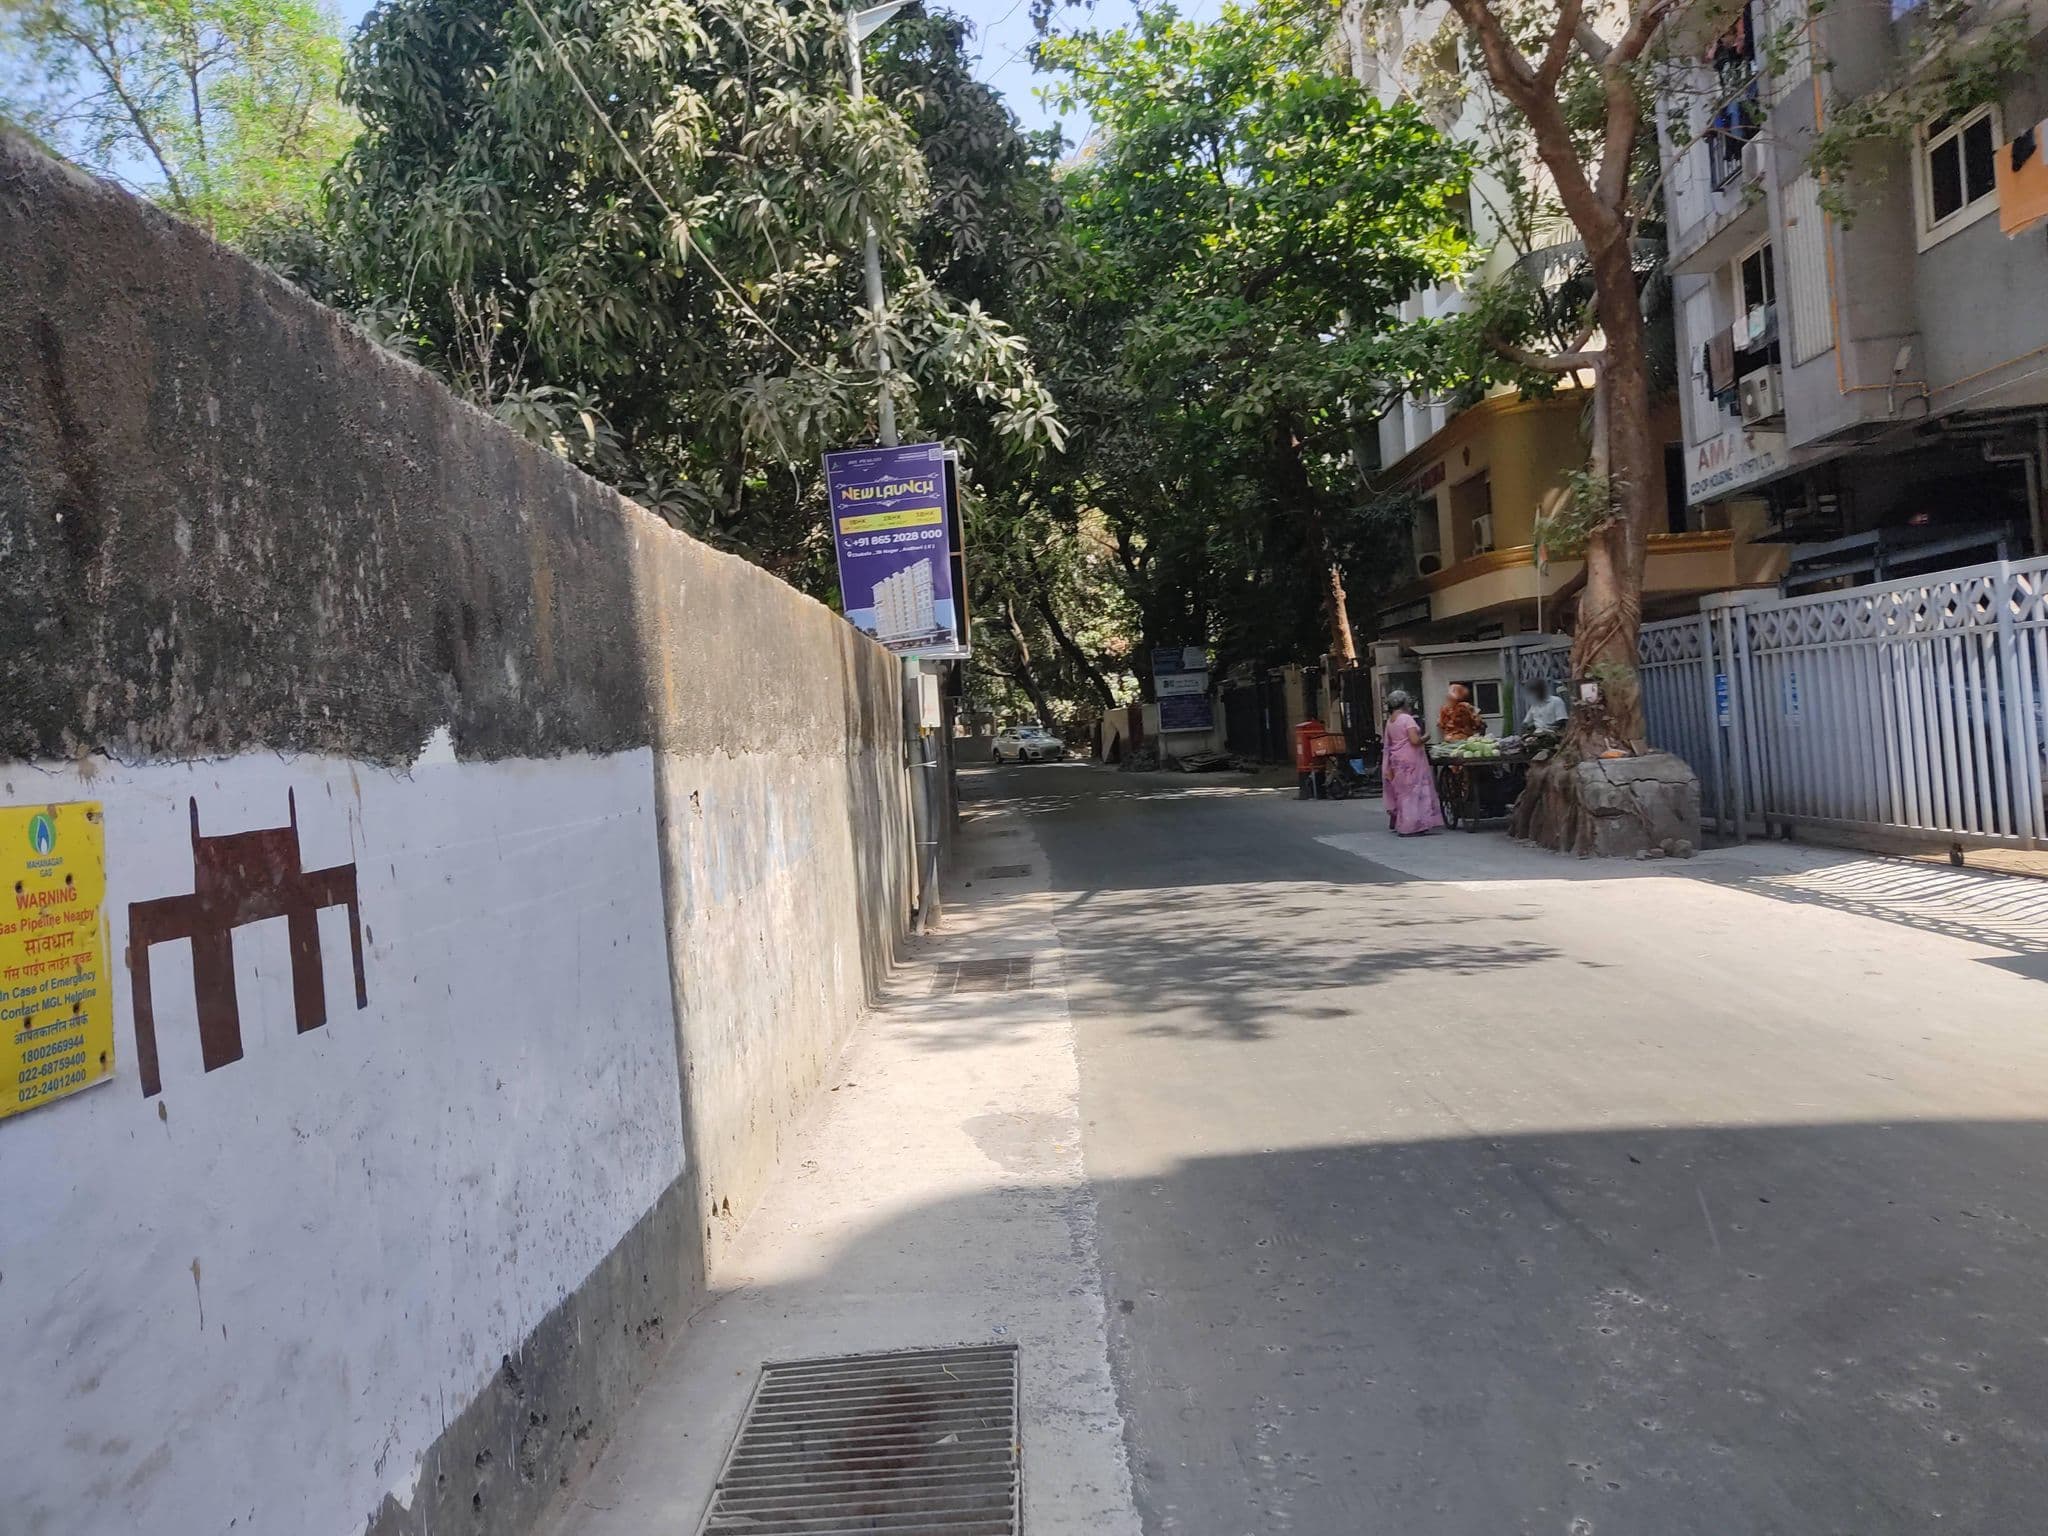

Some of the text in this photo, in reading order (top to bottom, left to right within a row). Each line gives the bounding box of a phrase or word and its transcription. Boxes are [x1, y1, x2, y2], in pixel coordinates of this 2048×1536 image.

[841, 480, 934, 500] NEW LAUNCH
[852, 537, 870, 547] +91
[921, 529, 942, 540] 000
[16, 887, 77, 910] WARNING
[20, 915, 60, 932] Pipeline
[63, 908, 95, 923] Nearby
[24, 931, 74, 956] सावधान
[12, 985, 37, 999] Case
[39, 979, 49, 993] of
[50, 970, 96, 990] Emergency
[0, 987, 97, 1021] Contact MGL Helpline
[21, 1034, 85, 1064] 18002669944
[18, 1051, 86, 1084] 022-68759400
[18, 1069, 87, 1102] 022-24012400
